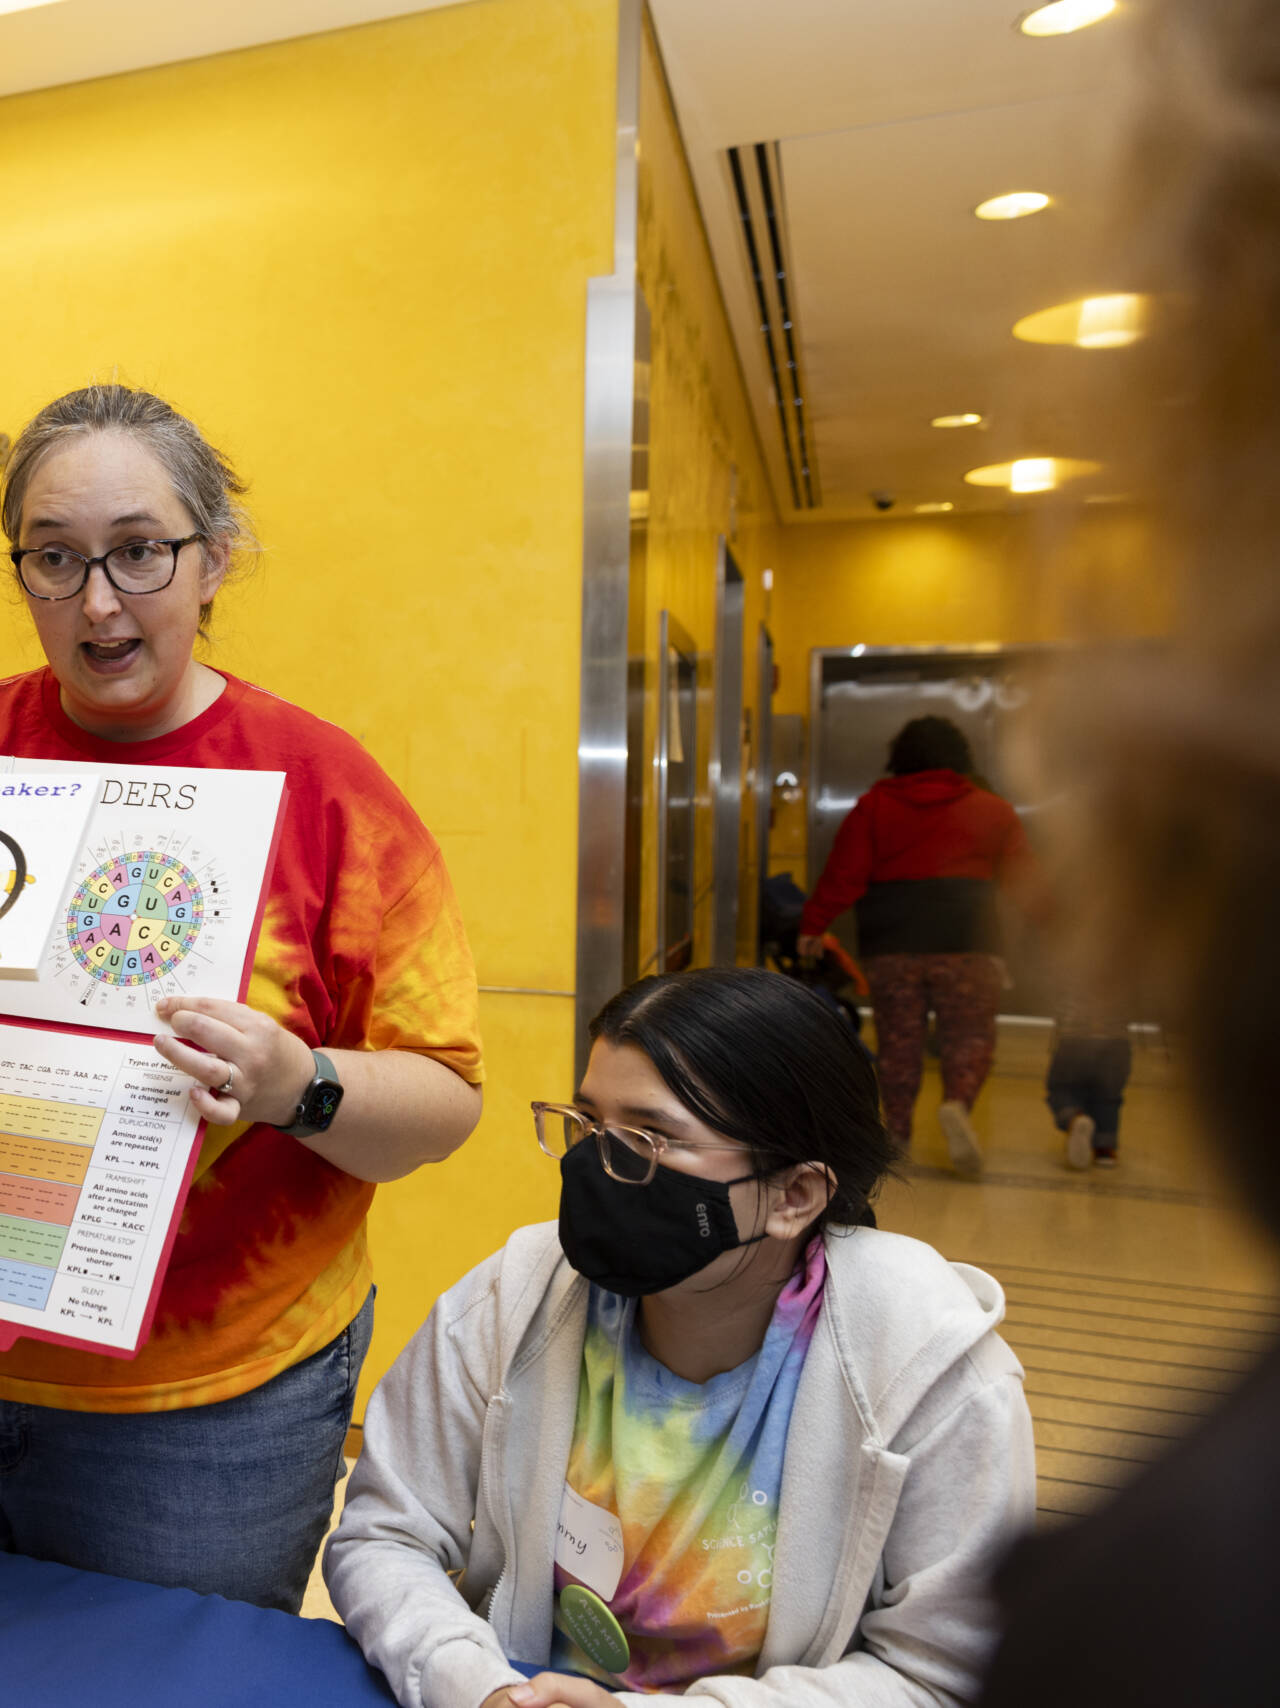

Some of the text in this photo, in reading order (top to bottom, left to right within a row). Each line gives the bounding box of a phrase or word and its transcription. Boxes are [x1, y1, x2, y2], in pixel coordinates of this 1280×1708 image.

[113, 873, 122, 883] A
[131, 868, 142, 878] G
[149, 869, 159, 879] U
[163, 877, 173, 888] C
[99, 883, 108, 894] C
[118, 895, 129, 908] G
[172, 891, 181, 901] A
[88, 899, 98, 908] U
[146, 898, 157, 910] U
[176, 908, 185, 918] G
[83, 915, 93, 926] G
[109, 923, 121, 936] A
[138, 926, 150, 939] C
[171, 924, 181, 935] U
[85, 933, 95, 943] A
[160, 941, 170, 951] C
[96, 947, 105, 957] C
[144, 952, 154, 963] A
[110, 955, 119, 966] U
[127, 957, 137, 969] G
[129, 1058, 149, 1067] Types
[140, 1086, 164, 1095] amino
[165, 1089, 182, 1097] acid
[138, 1093, 169, 1104] changed
[120, 1105, 135, 1113] KPL
[118, 1117, 166, 1130] DUPLICATION
[112, 1130, 163, 1144] Amino acid(s)
[124, 1142, 158, 1152] repeated
[105, 1155, 160, 1170] KPL KPPL
[105, 1187, 128, 1195] amino
[130, 1191, 149, 1199] acids
[88, 1192, 106, 1201] after
[113, 1197, 149, 1209] mutation
[106, 1205, 138, 1217] changed
[696, 1203, 710, 1237] enro
[77, 1229, 136, 1246] PREMATURE STOP
[71, 1242, 132, 1261] Protein becomes
[86, 1257, 114, 1267] shorter
[81, 1286, 105, 1297] SILENT
[68, 1296, 108, 1312] No change
[60, 1308, 113, 1326] KPL KPL
